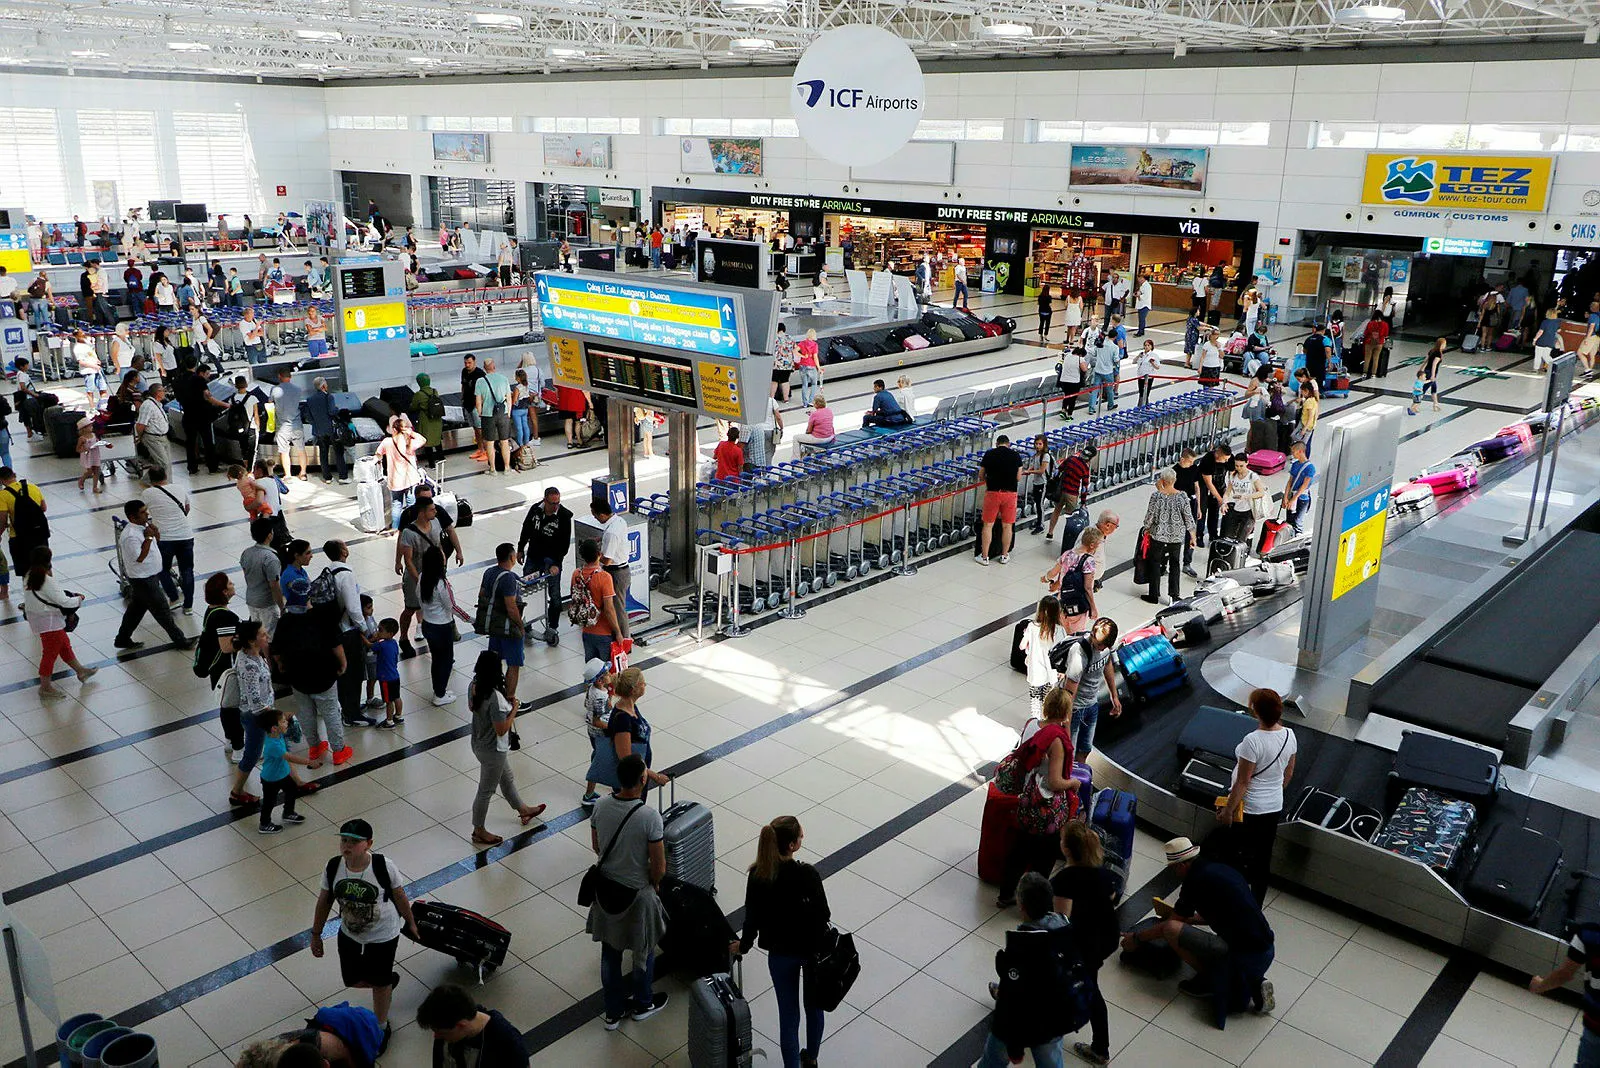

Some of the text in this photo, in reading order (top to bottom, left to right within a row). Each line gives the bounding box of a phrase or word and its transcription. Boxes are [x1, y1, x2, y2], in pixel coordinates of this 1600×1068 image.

[829, 88, 918, 111] ICF Airports
[1442, 166, 1533, 184] TEZ
[1447, 183, 1524, 194] tour
[750, 195, 772, 206] DUTY
[772, 196, 793, 207] FREE
[821, 200, 862, 212] ARRIVALS
[1438, 194, 1527, 205] www.tez-tour.com
[938, 207, 965, 219] DUTY
[966, 209, 992, 220] FREE
[1030, 213, 1082, 227] ARRIVALS
[1393, 210, 1440, 219] GÜMRÜK
[1452, 213, 1509, 222] CUSTOMS
[1179, 219, 1200, 234] via
[1571, 223, 1596, 242] ÇIKIŞ
